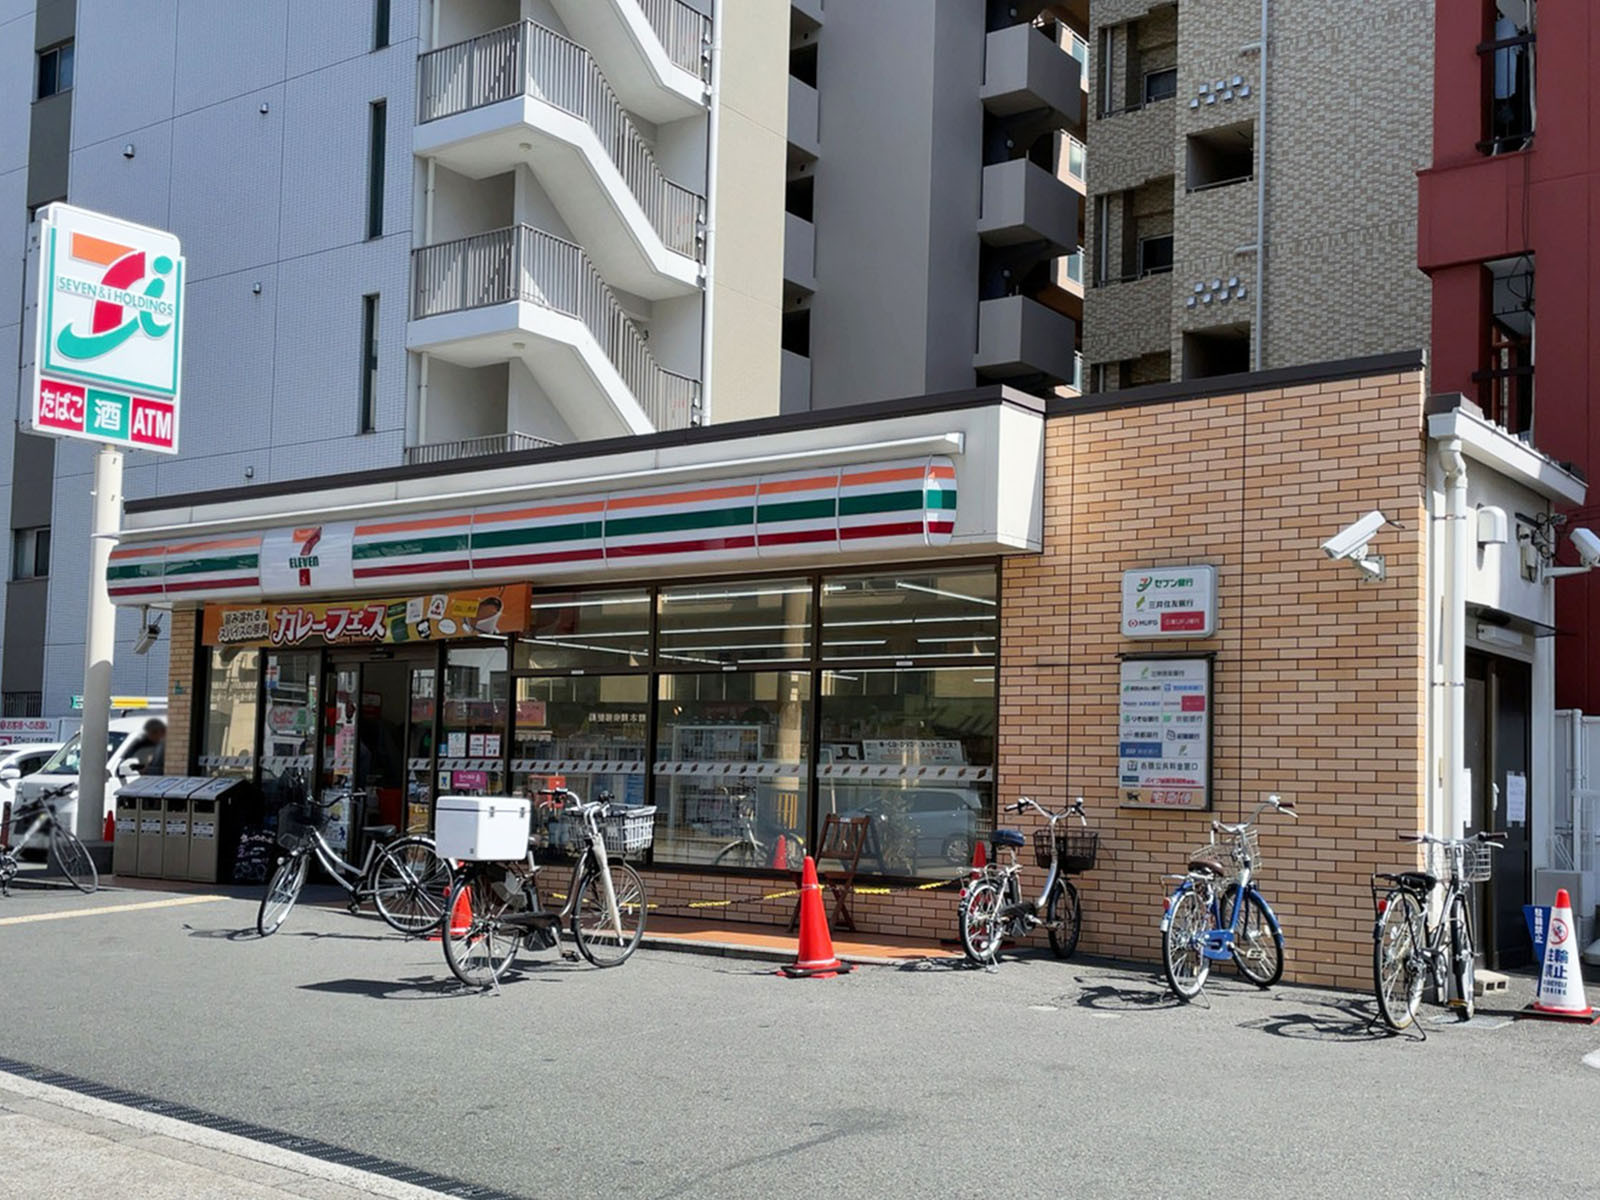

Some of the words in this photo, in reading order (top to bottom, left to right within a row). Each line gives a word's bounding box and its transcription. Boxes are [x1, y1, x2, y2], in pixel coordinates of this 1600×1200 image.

[113, 291, 174, 317] HOLDINGS
[41, 388, 84, 424] たばこ
[94, 398, 123, 431] 酒
[133, 405, 173, 441] ATM
[1154, 578, 1194, 588] セブン銀行
[1148, 599, 1194, 609] 三井住友銀行
[273, 604, 388, 644] カレーフェス
